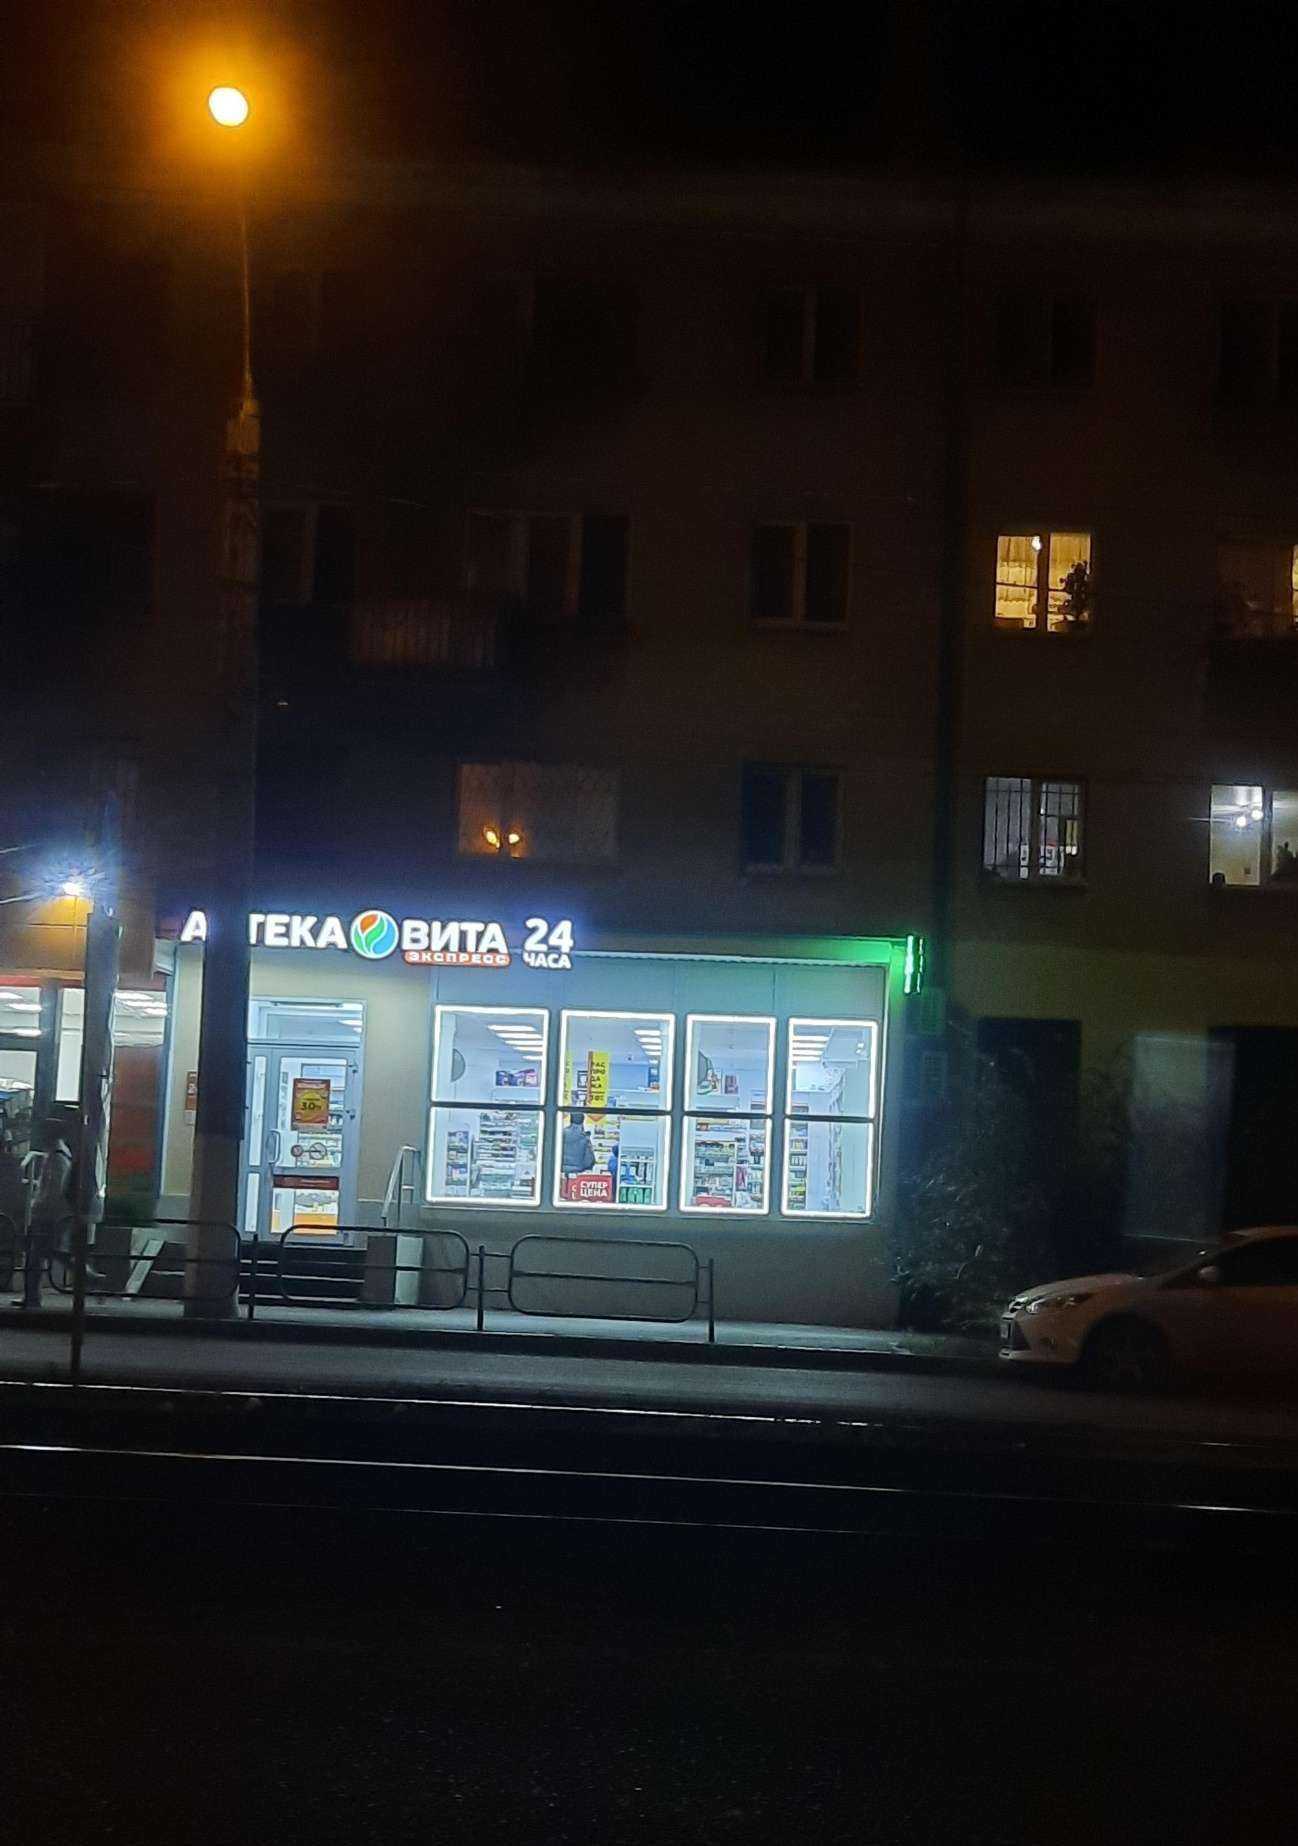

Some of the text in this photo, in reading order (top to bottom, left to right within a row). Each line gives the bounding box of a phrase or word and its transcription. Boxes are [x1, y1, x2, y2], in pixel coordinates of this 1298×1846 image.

[180, 910, 509, 954] АТЕКА ВИТА
[523, 917, 574, 953] 24
[407, 951, 507, 965] ЭКСПРЕСС
[523, 952, 571, 969] ЧАСА
[580, 1180, 608, 1189] СУПЕР
[580, 1188, 608, 1198] ЦЕНА
